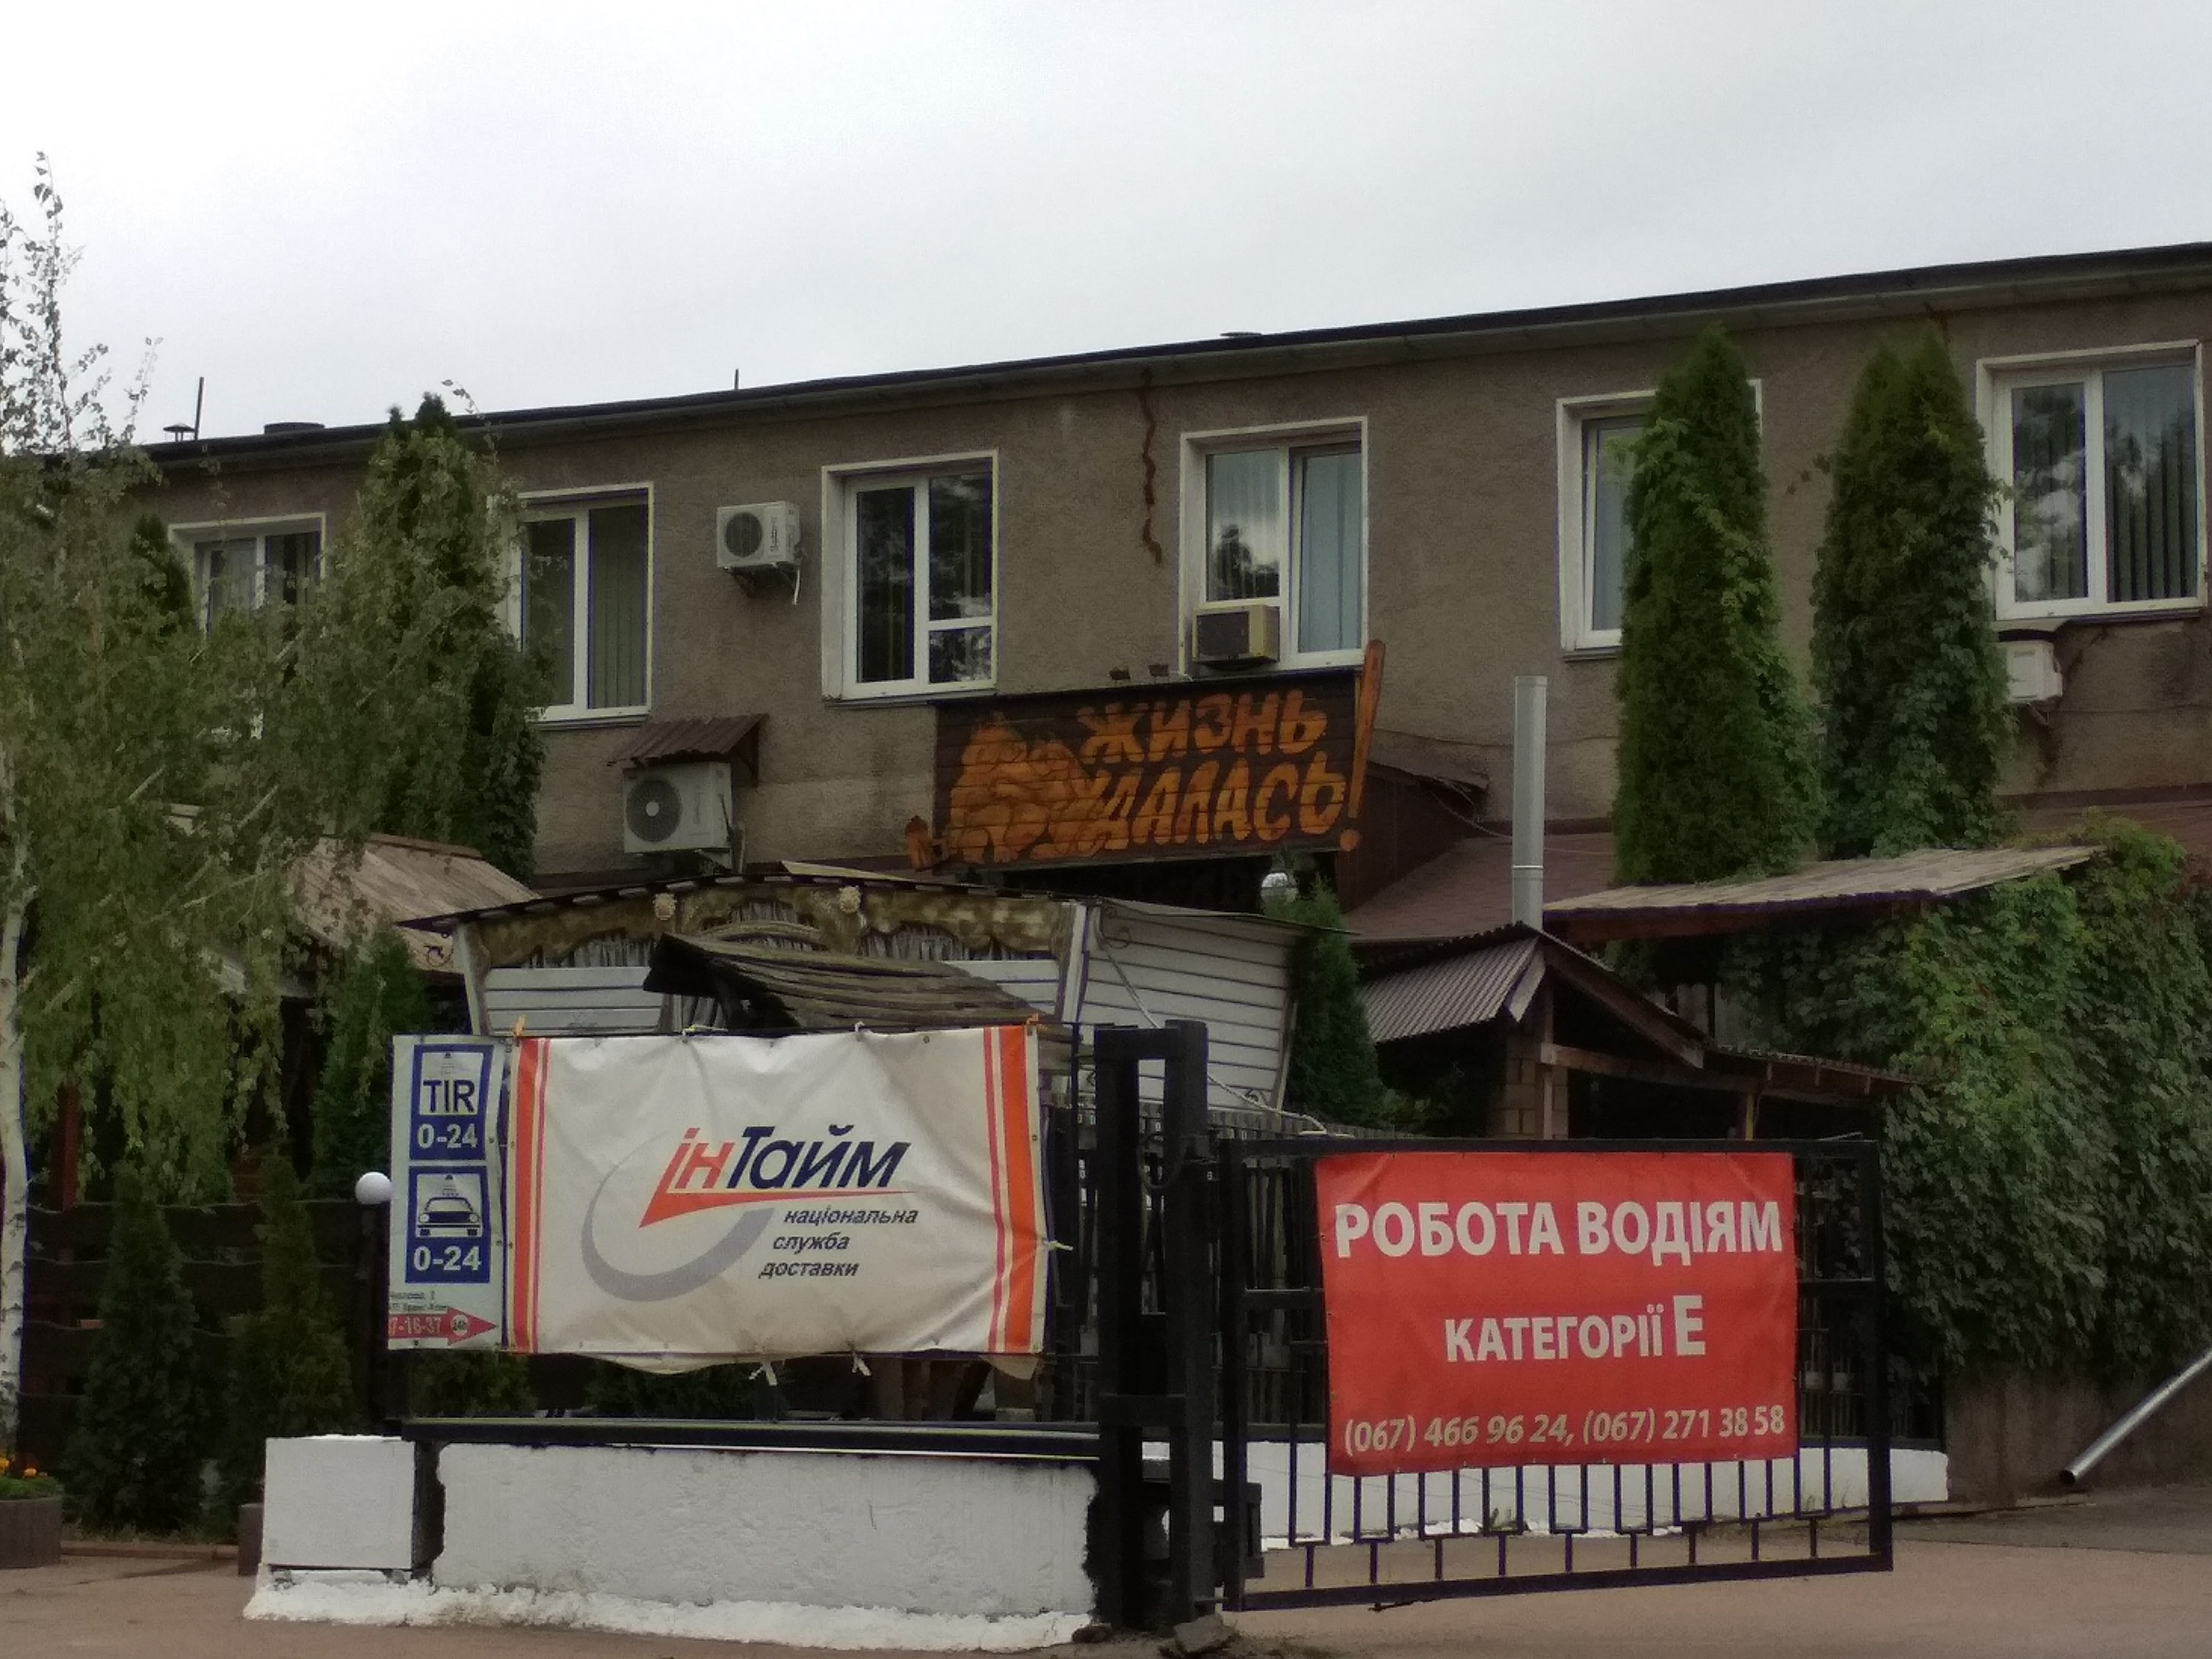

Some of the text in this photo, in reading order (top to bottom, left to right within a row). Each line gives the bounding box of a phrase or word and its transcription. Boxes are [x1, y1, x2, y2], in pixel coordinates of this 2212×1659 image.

[1076, 689, 1327, 764] ЖИЗНЬ
[423, 1079, 477, 1114] TIR
[417, 1122, 477, 1149] 0-24
[784, 1205, 919, 1225] національна
[773, 1232, 851, 1255] служба
[1335, 1201, 1783, 1267] РОБОТА ВОДІЯМ
[413, 1245, 481, 1272] 0-24
[758, 1261, 860, 1279] доставки
[1444, 1295, 1706, 1362] КАТЕГОРІЇ Е
[1344, 1415, 1417, 1456] (067)
[1425, 1415, 1478, 1448] 466
[1487, 1414, 1524, 1445] 96
[1534, 1413, 1574, 1447] 24,
[1582, 1407, 1655, 1445] (067)
[1662, 1409, 1710, 1439] 271
